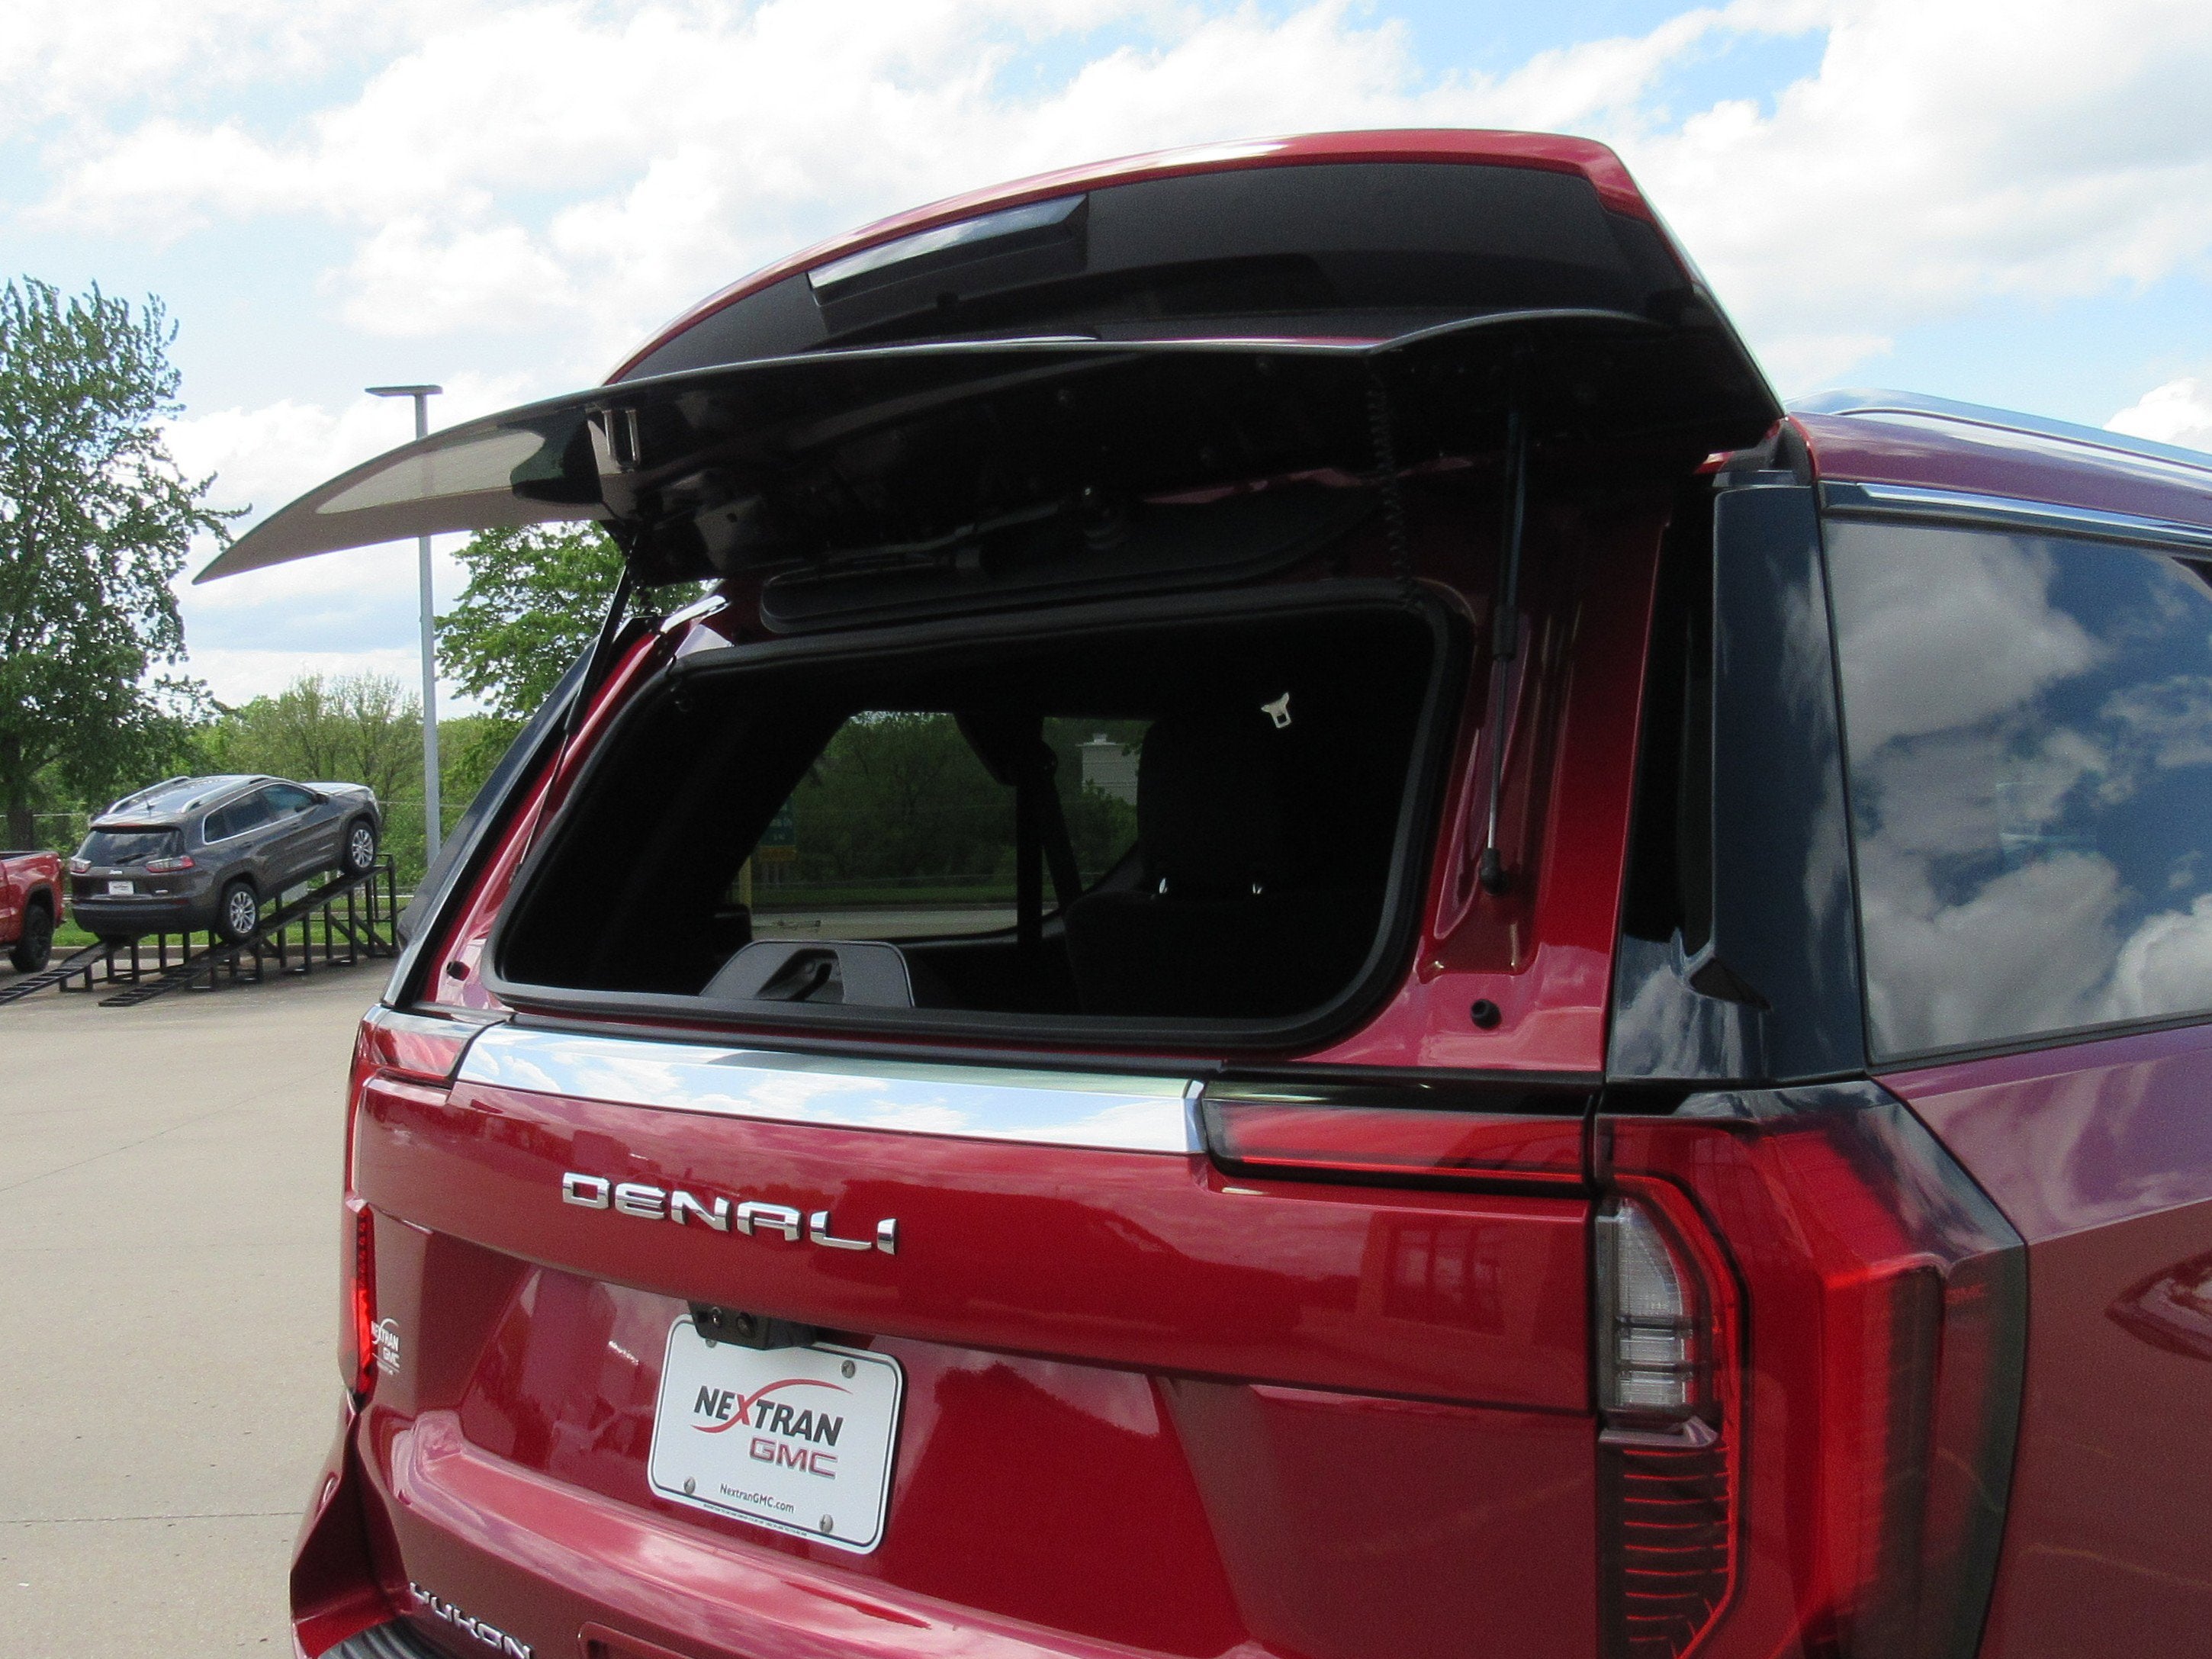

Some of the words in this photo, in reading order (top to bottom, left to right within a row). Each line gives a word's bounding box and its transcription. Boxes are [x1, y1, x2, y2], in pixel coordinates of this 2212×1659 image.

[562, 1172, 898, 1256] DENALI
[693, 1384, 844, 1447] NEXTRAN
[750, 1436, 838, 1479] GMC
[719, 1482, 795, 1514] NextranGMC.com
[410, 1581, 535, 1659] YUKON
